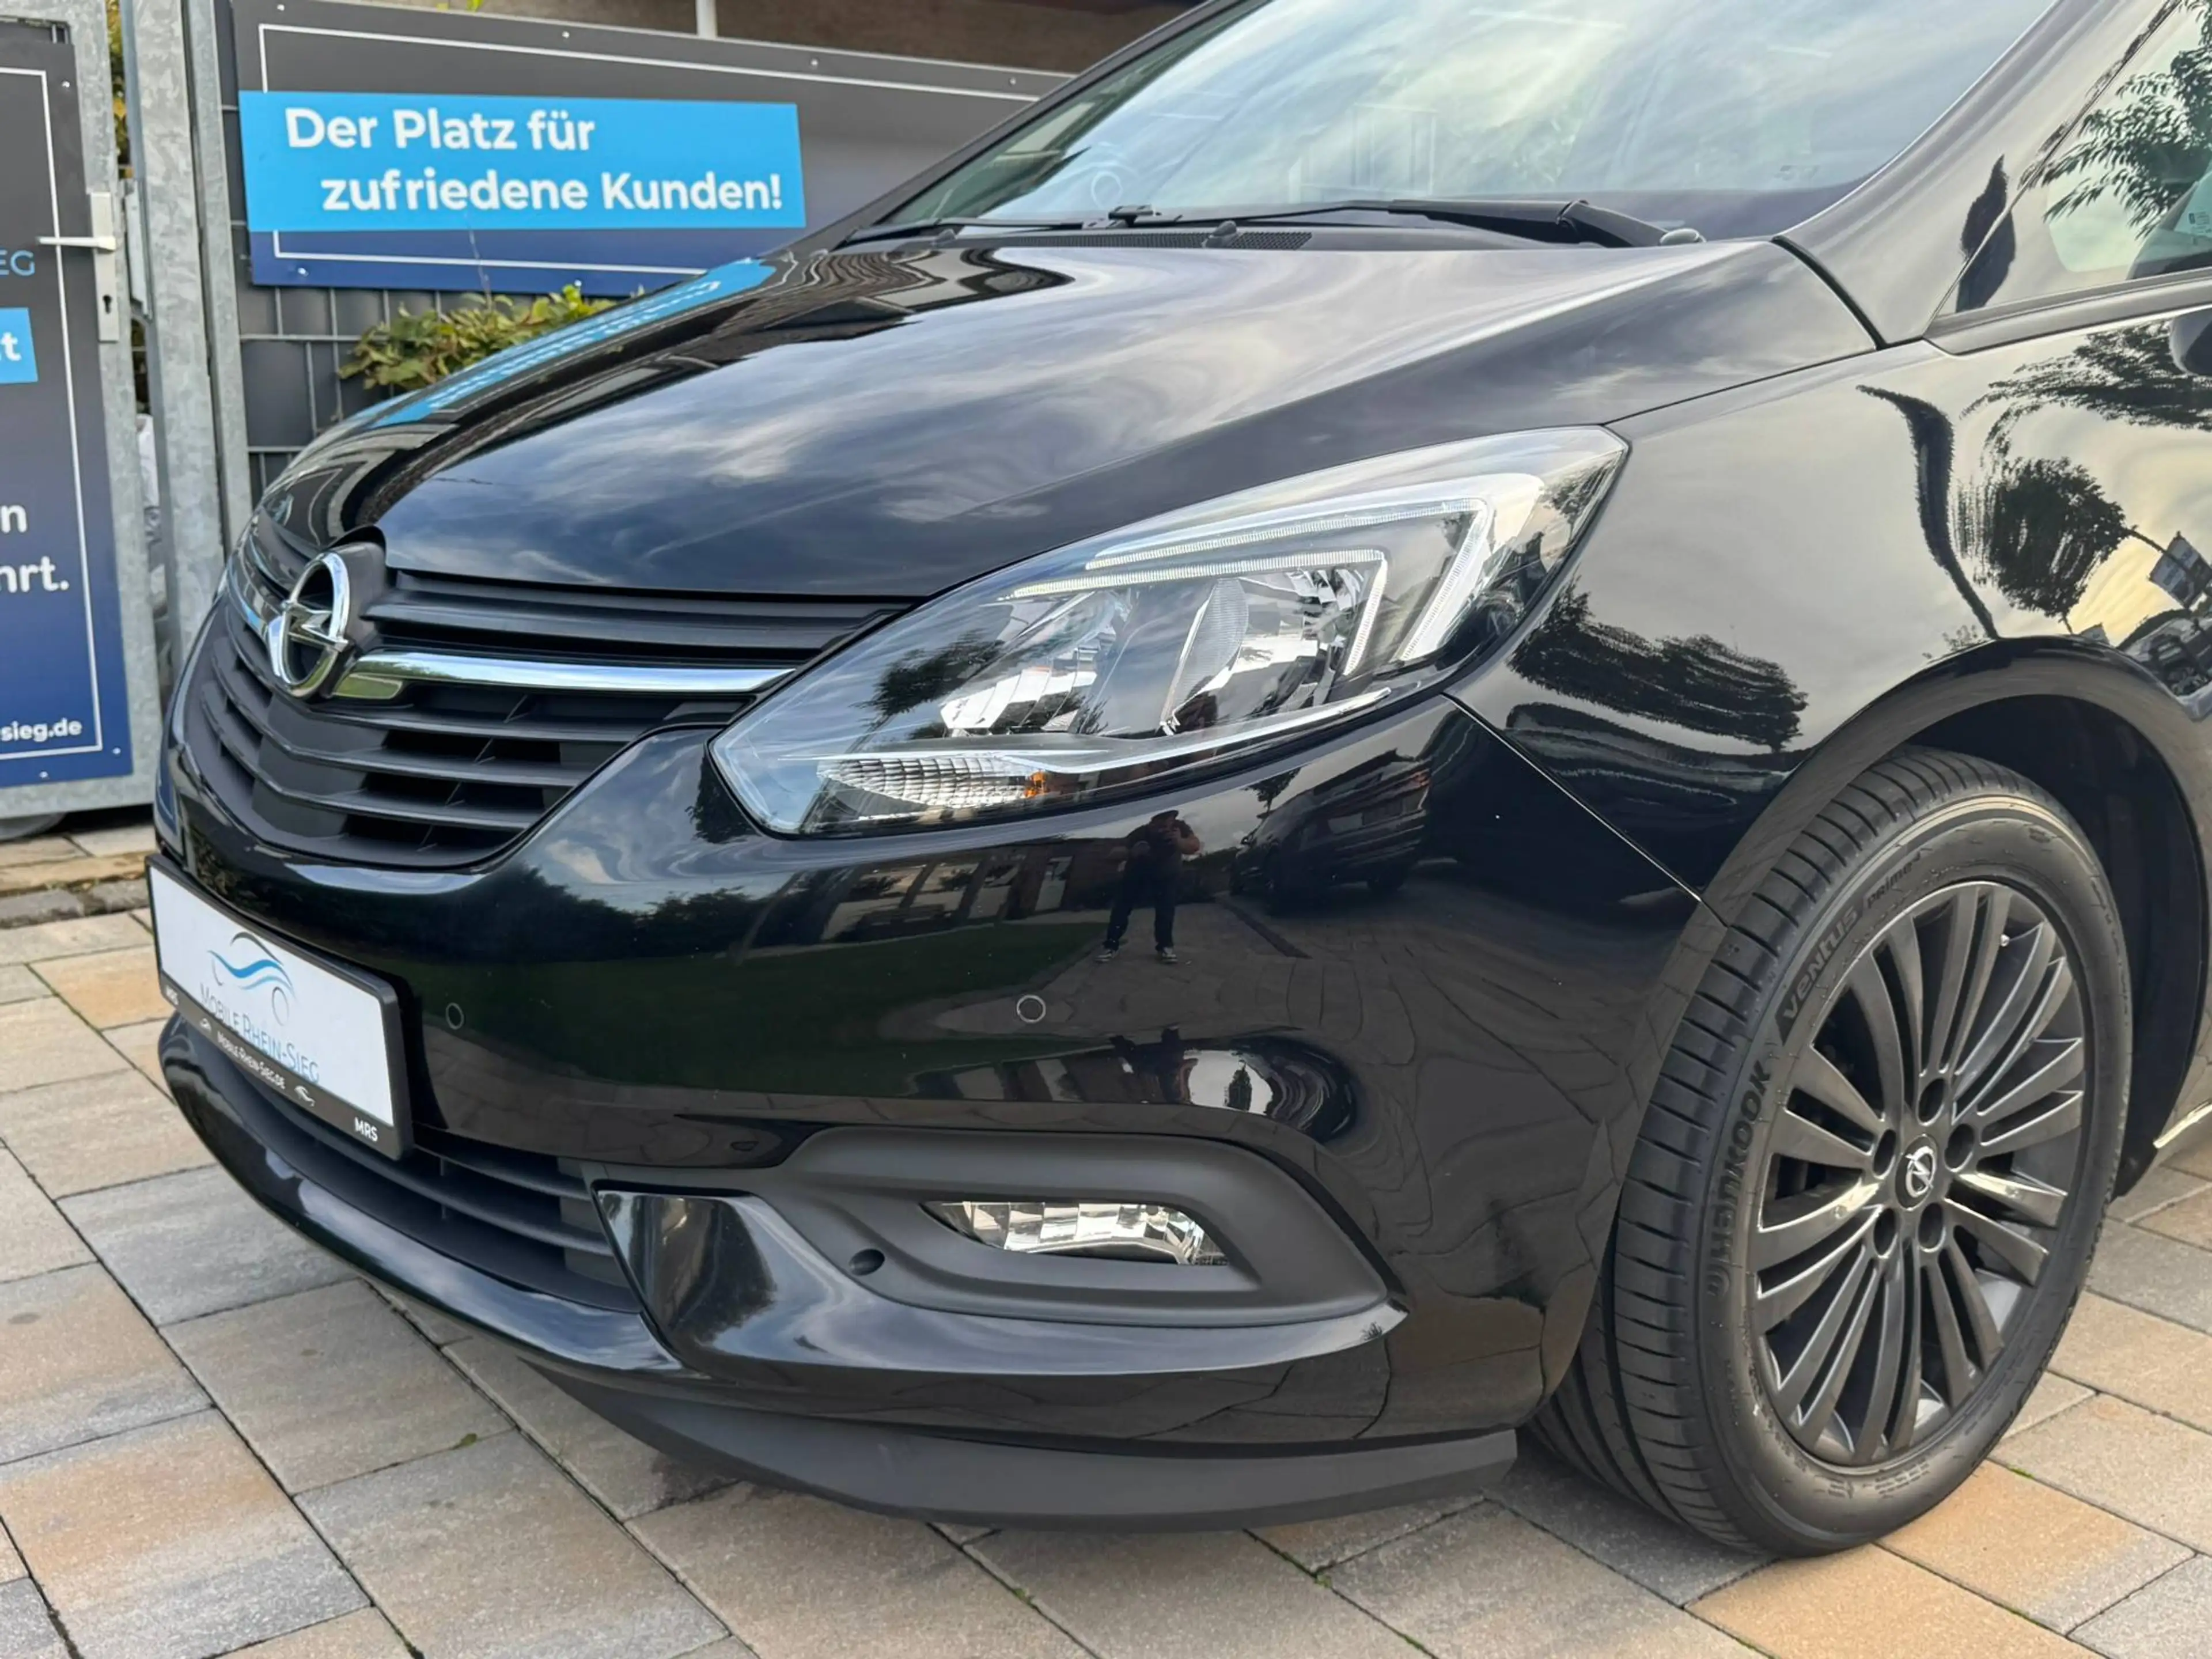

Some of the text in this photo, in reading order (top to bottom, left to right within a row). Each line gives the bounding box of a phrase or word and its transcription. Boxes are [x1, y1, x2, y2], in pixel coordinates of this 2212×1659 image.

[285, 107, 596, 151] Der Platz für
[321, 169, 782, 211] zufriedene Kunden!
[354, 1116, 378, 1142] MRS
